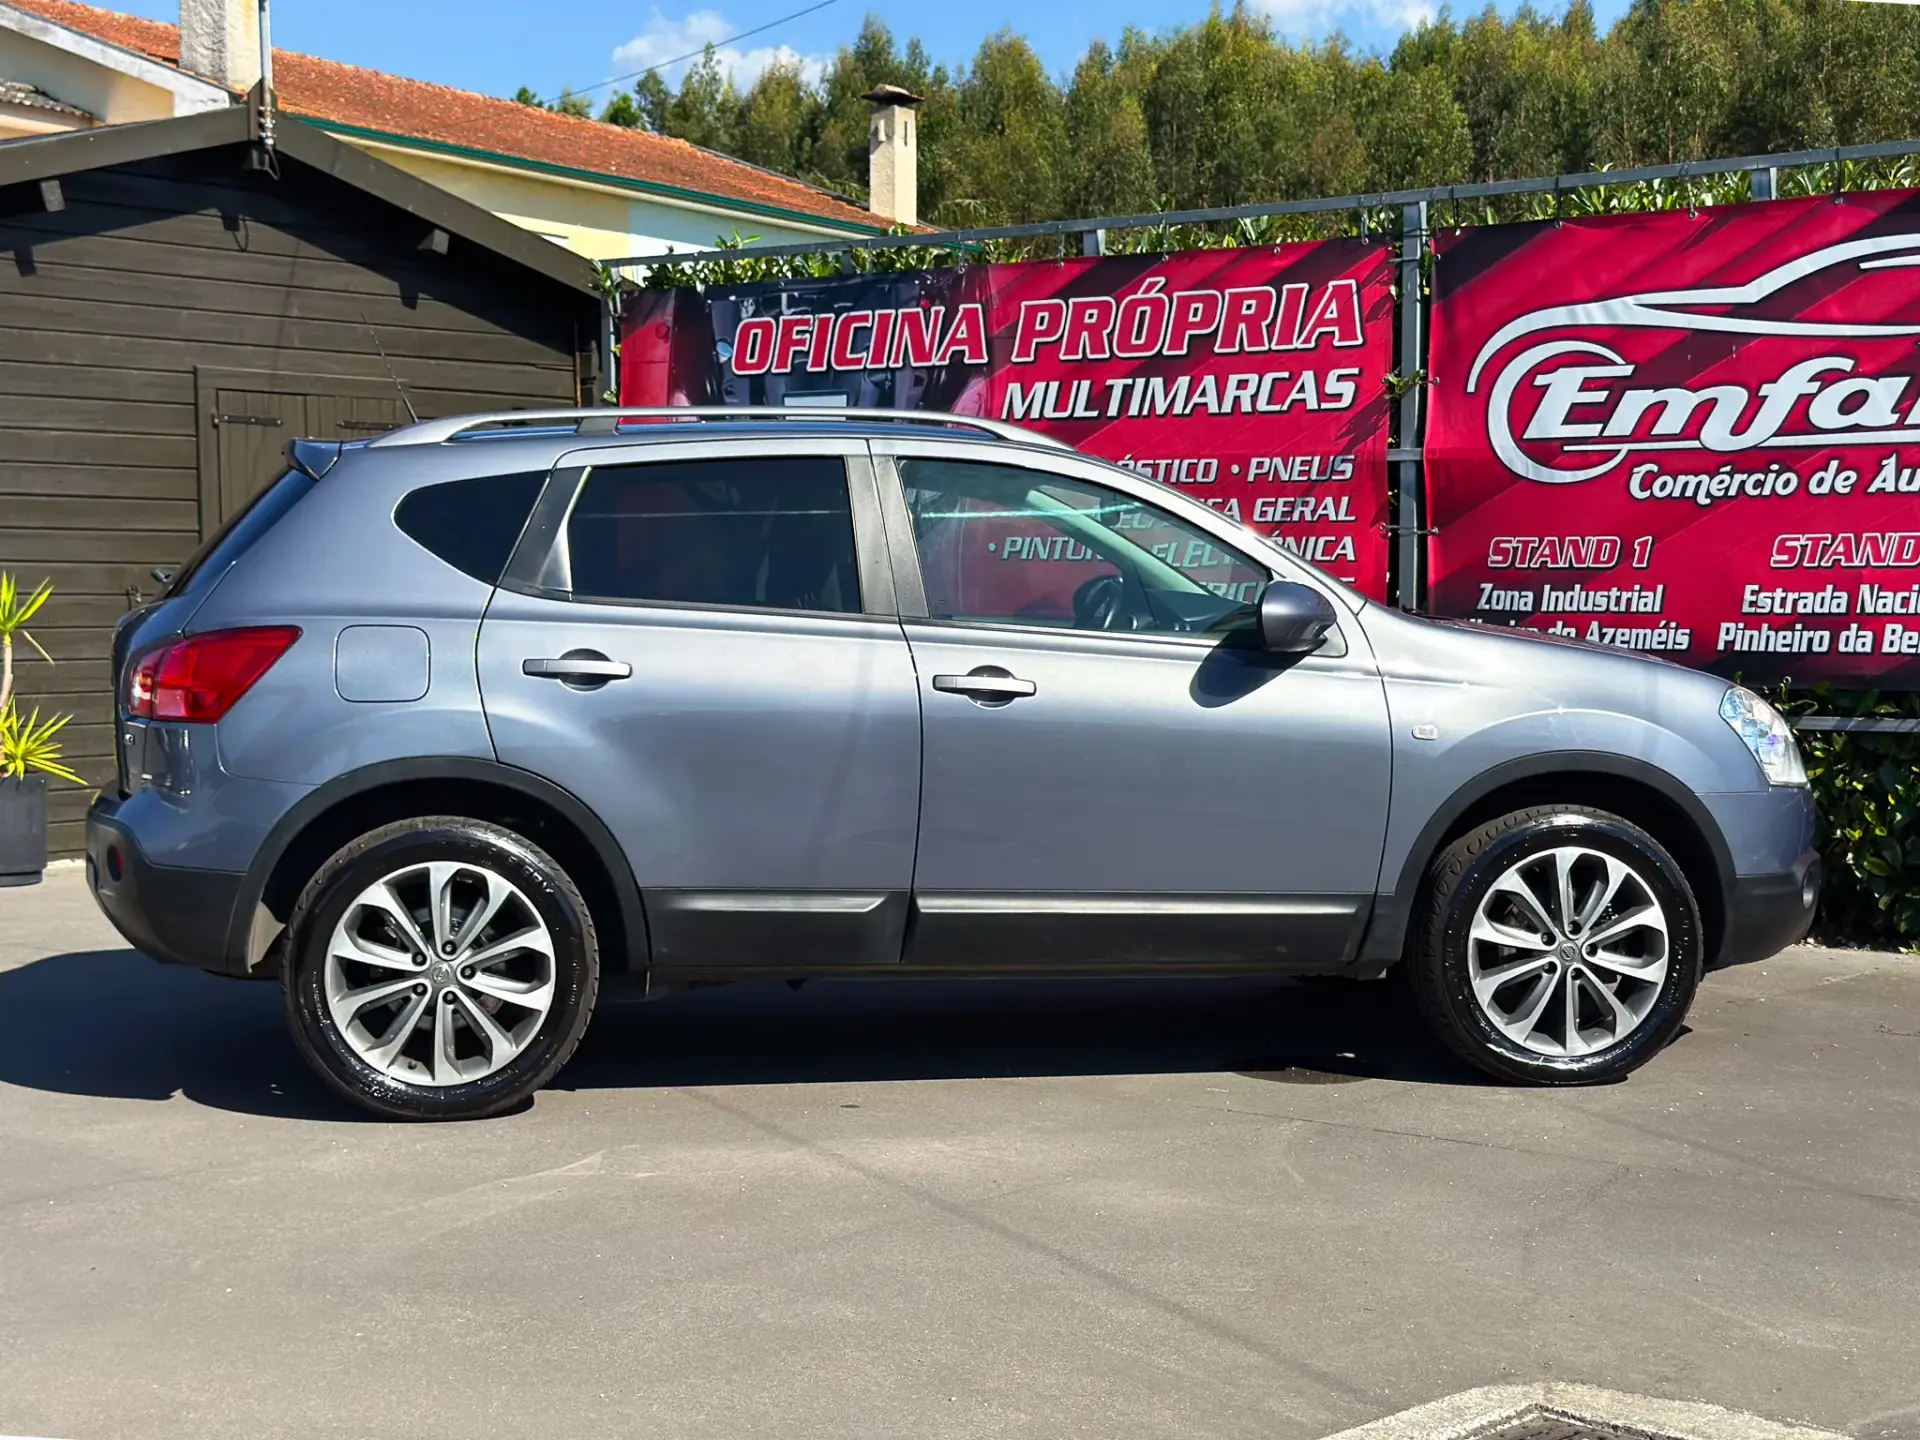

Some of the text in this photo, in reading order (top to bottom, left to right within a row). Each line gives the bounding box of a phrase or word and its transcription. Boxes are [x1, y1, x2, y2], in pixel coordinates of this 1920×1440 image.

[730, 275, 1365, 376] OFICINA PRÓPRIA
[1001, 367, 1360, 421] MULTIMARCAS
[1522, 355, 1920, 452] Emfa
[1246, 454, 1355, 483] PNEUS
[1629, 462, 1798, 505] Comércio
[1808, 459, 1857, 495] de
[1253, 495, 1356, 523] GERAL
[1487, 536, 1653, 568] STAND 1
[1769, 533, 1920, 568] STAND
[1476, 582, 1664, 613] Zona Industrial
[1741, 584, 1920, 615] Estrada Naci
[1585, 619, 1691, 651] Azeméis
[1716, 622, 1920, 654] Pinheiro da Be
